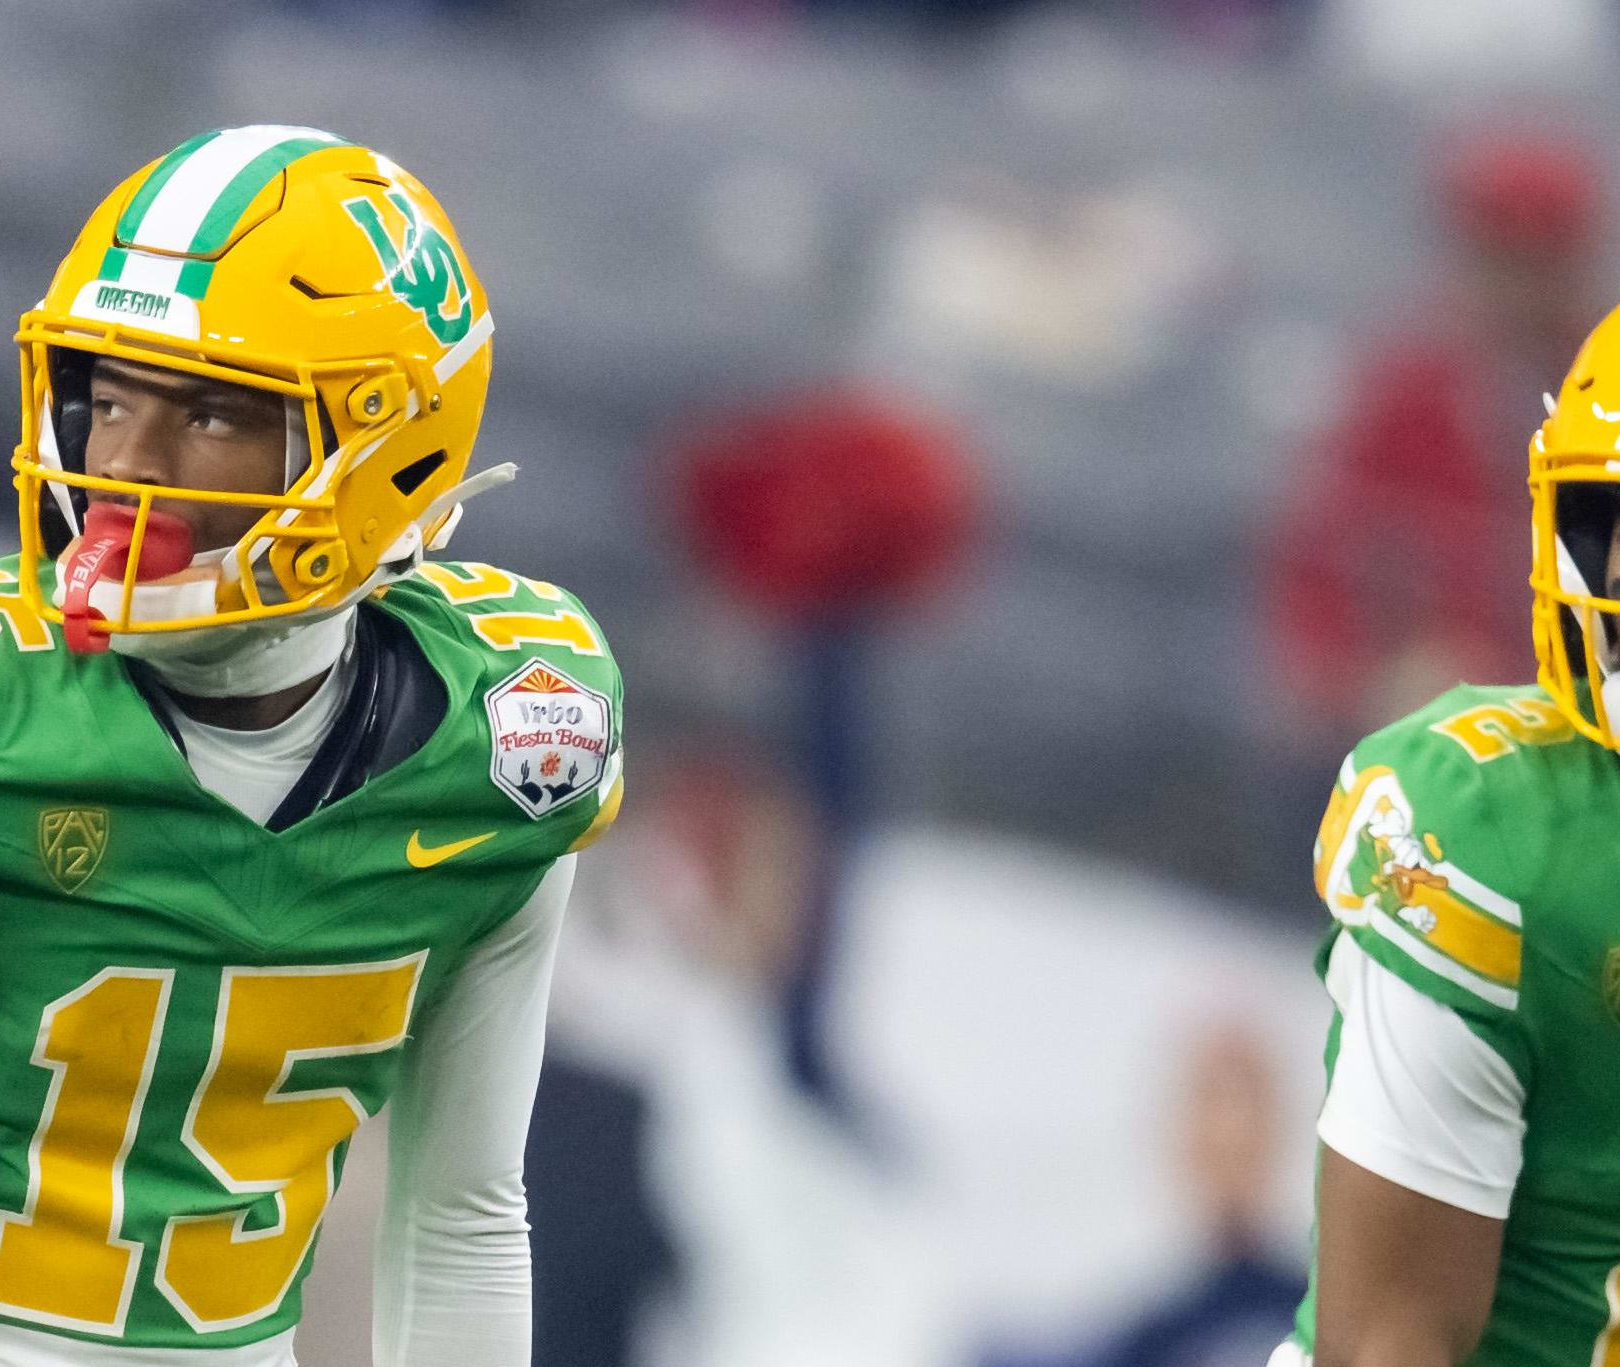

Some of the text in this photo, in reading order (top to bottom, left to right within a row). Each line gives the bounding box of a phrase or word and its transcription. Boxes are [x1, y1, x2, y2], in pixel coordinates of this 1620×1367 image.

[96, 286, 171, 320] OREGON
[518, 698, 584, 725] Vrbo
[500, 728, 605, 754] Fiesta Bowl
[1428, 698, 1577, 764] 2
[43, 810, 105, 858] PAC
[56, 845, 90, 878] 12
